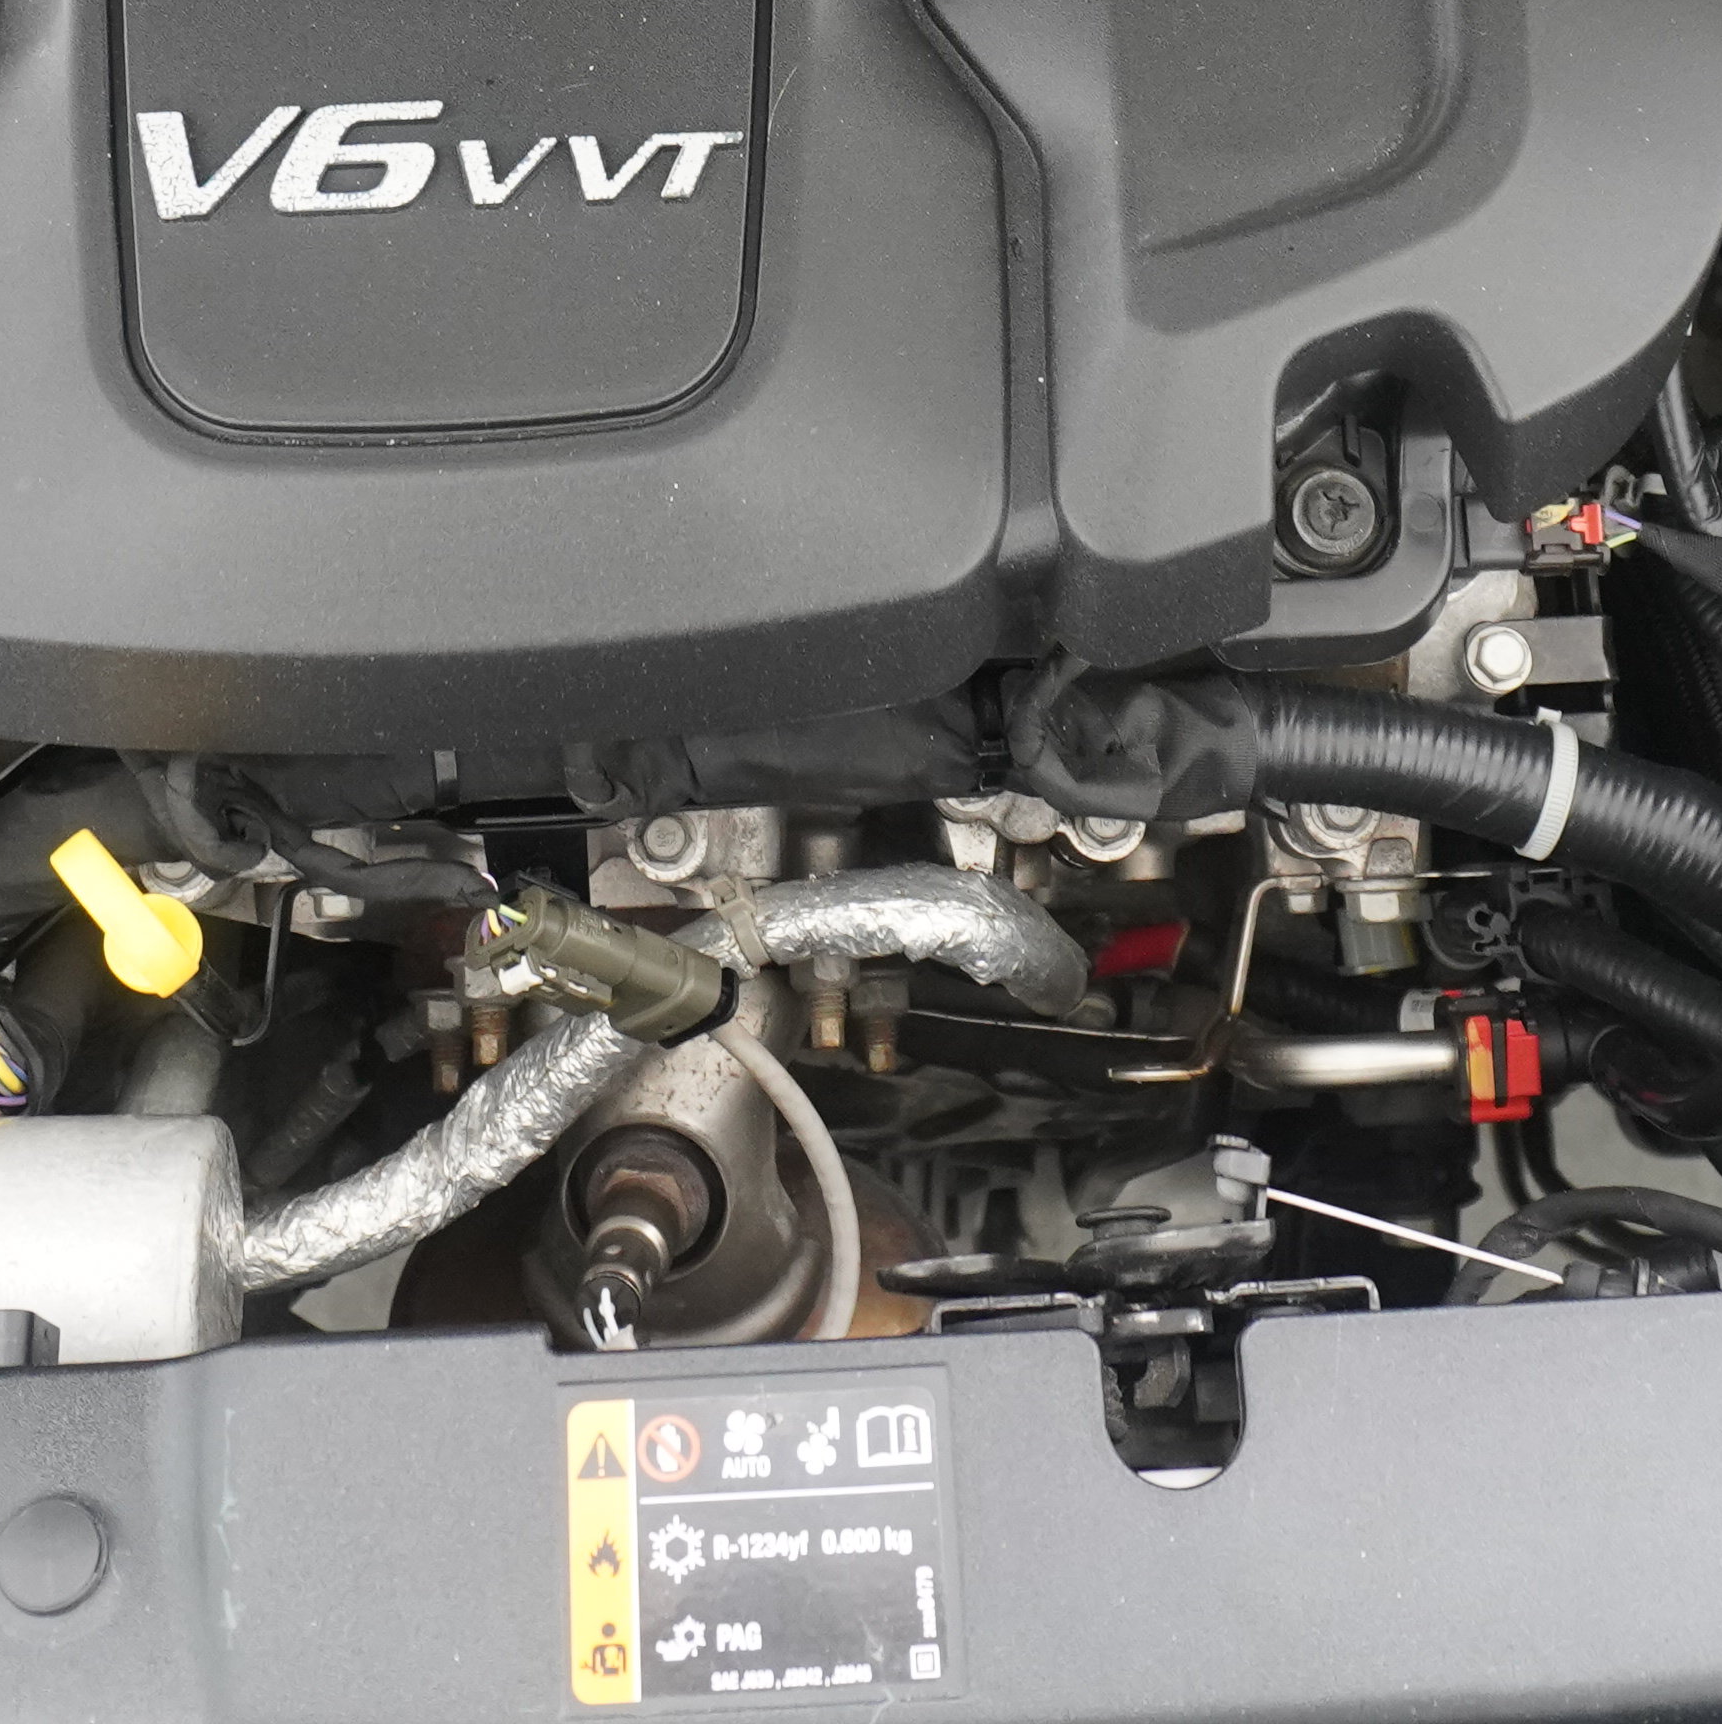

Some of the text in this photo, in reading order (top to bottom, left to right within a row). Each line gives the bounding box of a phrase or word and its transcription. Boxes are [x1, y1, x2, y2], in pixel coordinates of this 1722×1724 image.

[136, 100, 745, 222] V6 VVT
[722, 1455, 771, 1479] AUTO
[712, 1530, 809, 1561] R-1234yf
[884, 1525, 913, 1555] kg
[715, 1620, 763, 1653] PAG
